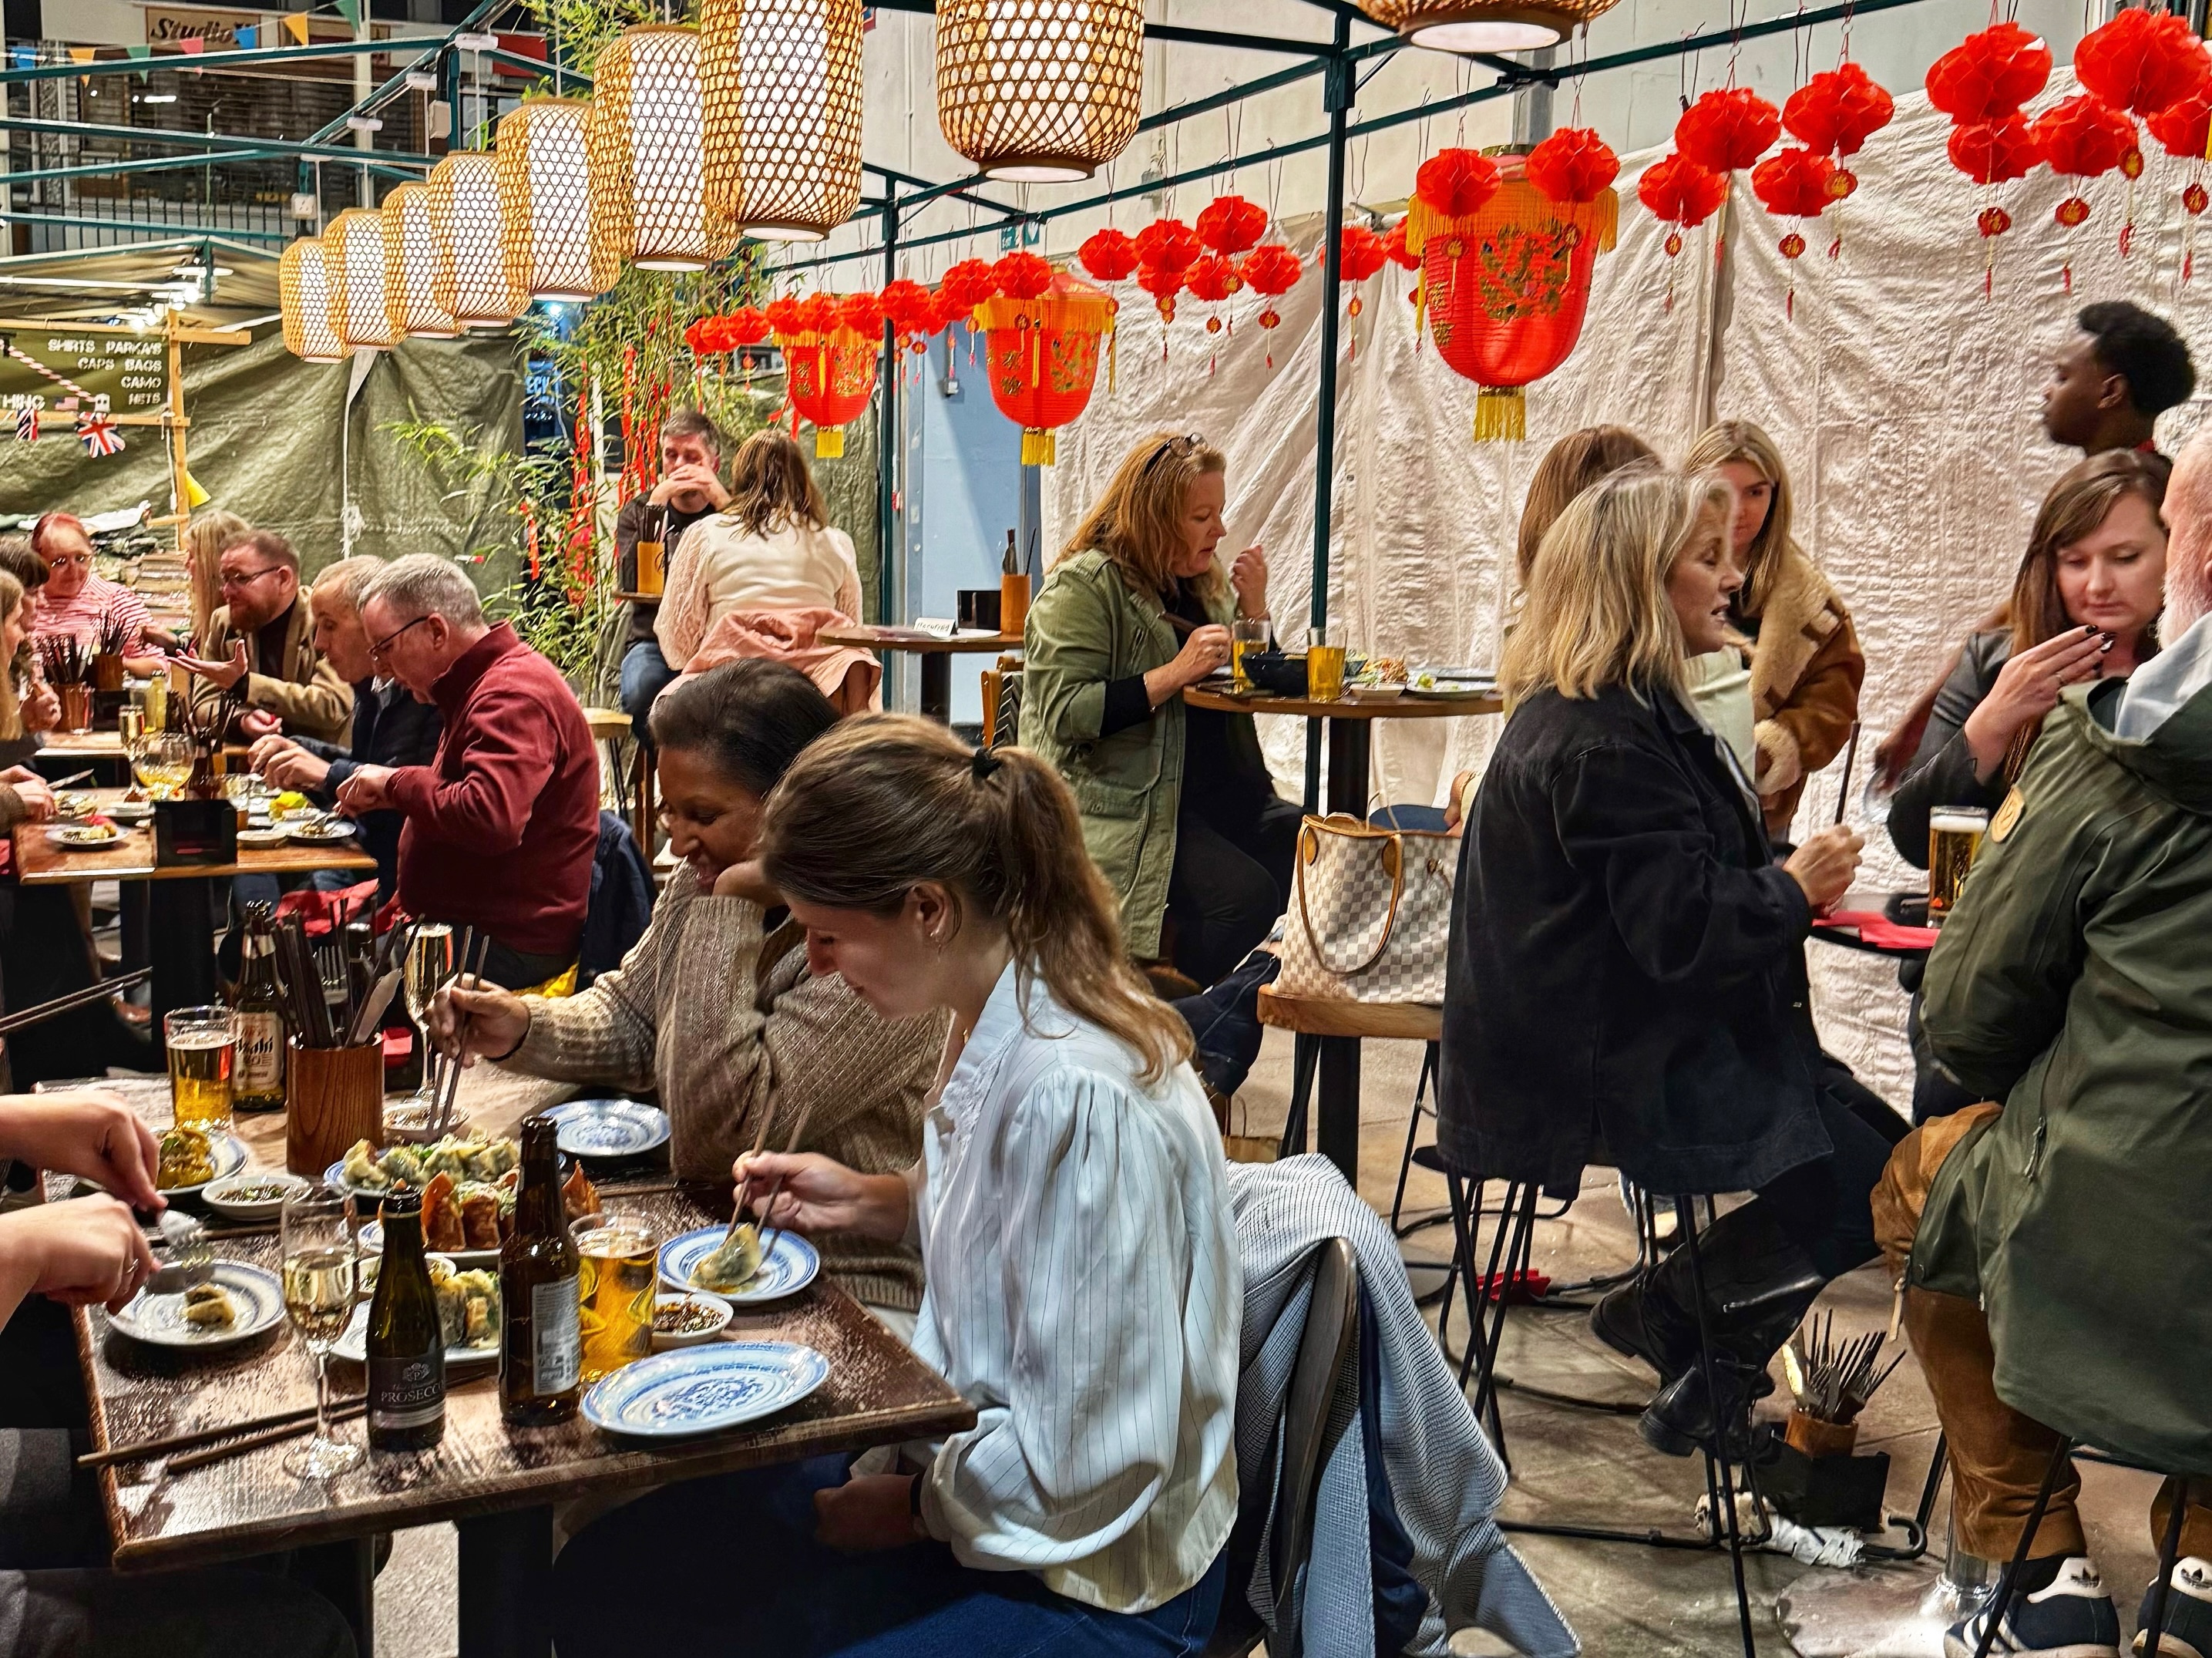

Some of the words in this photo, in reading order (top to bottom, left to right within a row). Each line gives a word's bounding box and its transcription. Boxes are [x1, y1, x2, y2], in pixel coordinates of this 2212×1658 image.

[150, 18, 233, 44] Studio
[48, 338, 96, 354] SHIRTS
[78, 357, 115, 371] CAPS
[124, 358, 162, 372] BAGS
[121, 375, 162, 389] CAMO
[0, 394, 45, 410] HING
[129, 392, 161, 405] NETS
